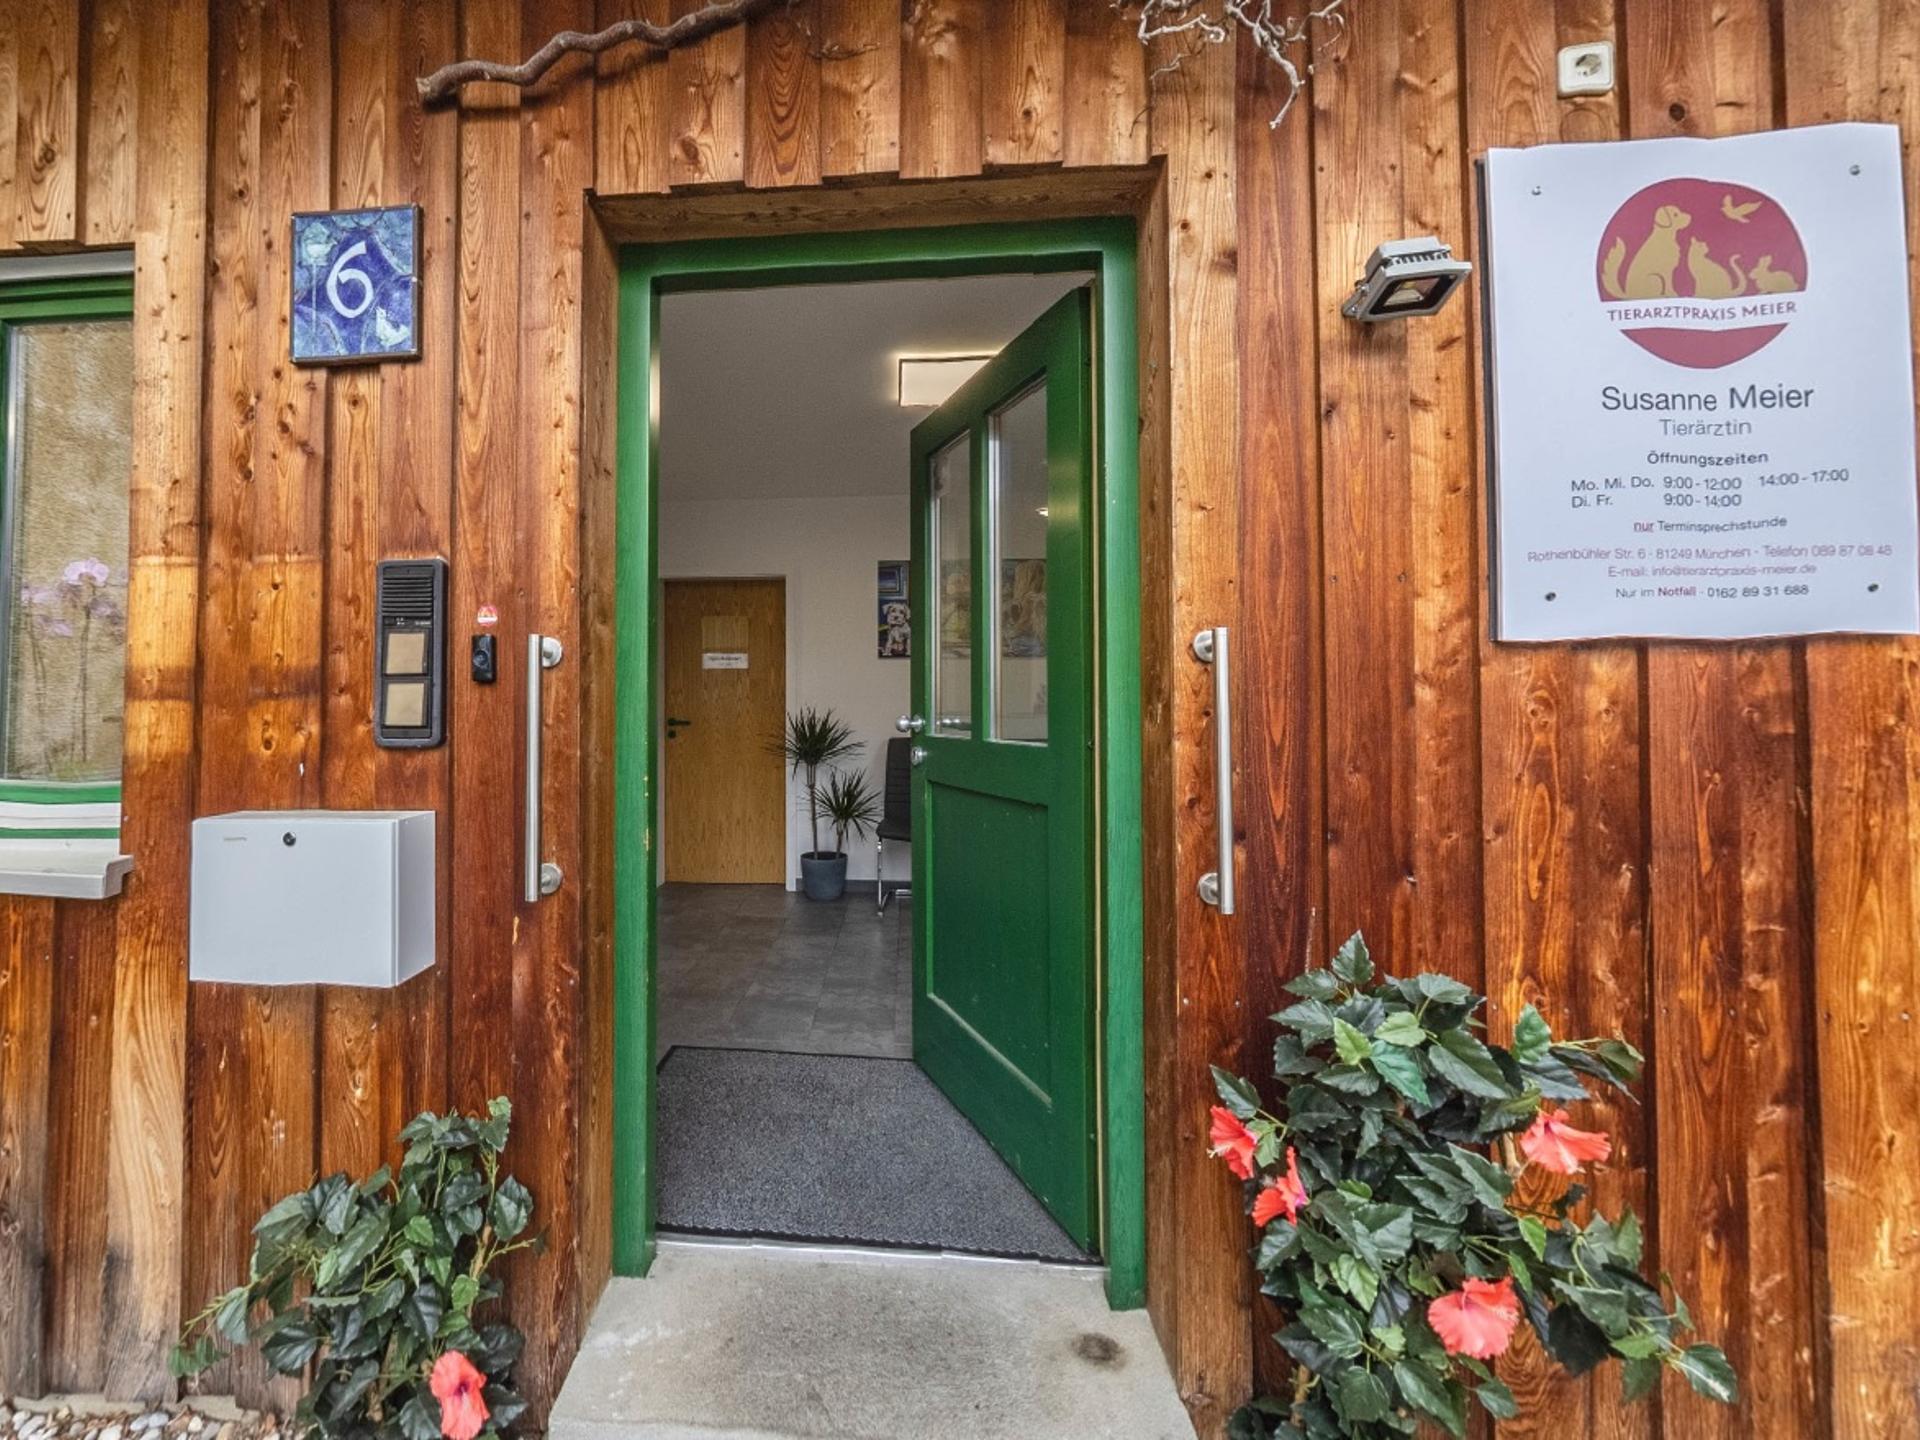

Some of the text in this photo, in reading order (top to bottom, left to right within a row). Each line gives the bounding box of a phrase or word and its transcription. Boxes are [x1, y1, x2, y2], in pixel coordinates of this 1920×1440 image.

[326, 241, 374, 319] 6
[1606, 301, 1797, 321] TIERARZTPRAXIS MEIER
[1601, 383, 1815, 411] Susanne Meier
[1659, 418, 1752, 436] Tierärztin
[1647, 450, 1769, 467] Öffnungszeiten
[1571, 479, 1599, 491] Mo.
[1604, 478, 1626, 489] Mi.
[1631, 476, 1654, 488] Do.
[1571, 495, 1591, 508] Di.
[1596, 494, 1613, 506] Fr.
[1633, 517, 1787, 533] nur Terminsprechstunde
[1614, 548, 1633, 560] Str.
[1637, 549, 1646, 559] 6
[1656, 549, 1692, 559] 81249
[1695, 547, 1750, 560] München
[1763, 545, 1808, 557] Telefon
[1811, 545, 1836, 557] 089
[1608, 566, 1648, 577] E-mail:
[1616, 588, 1637, 599] Nur
[1641, 588, 1654, 597] im
[1658, 586, 1696, 597] Notfall
[1707, 587, 1738, 598] 0162
[1742, 586, 1759, 597] 89
[1763, 586, 1779, 596] 31
[1784, 585, 1809, 595] 688
